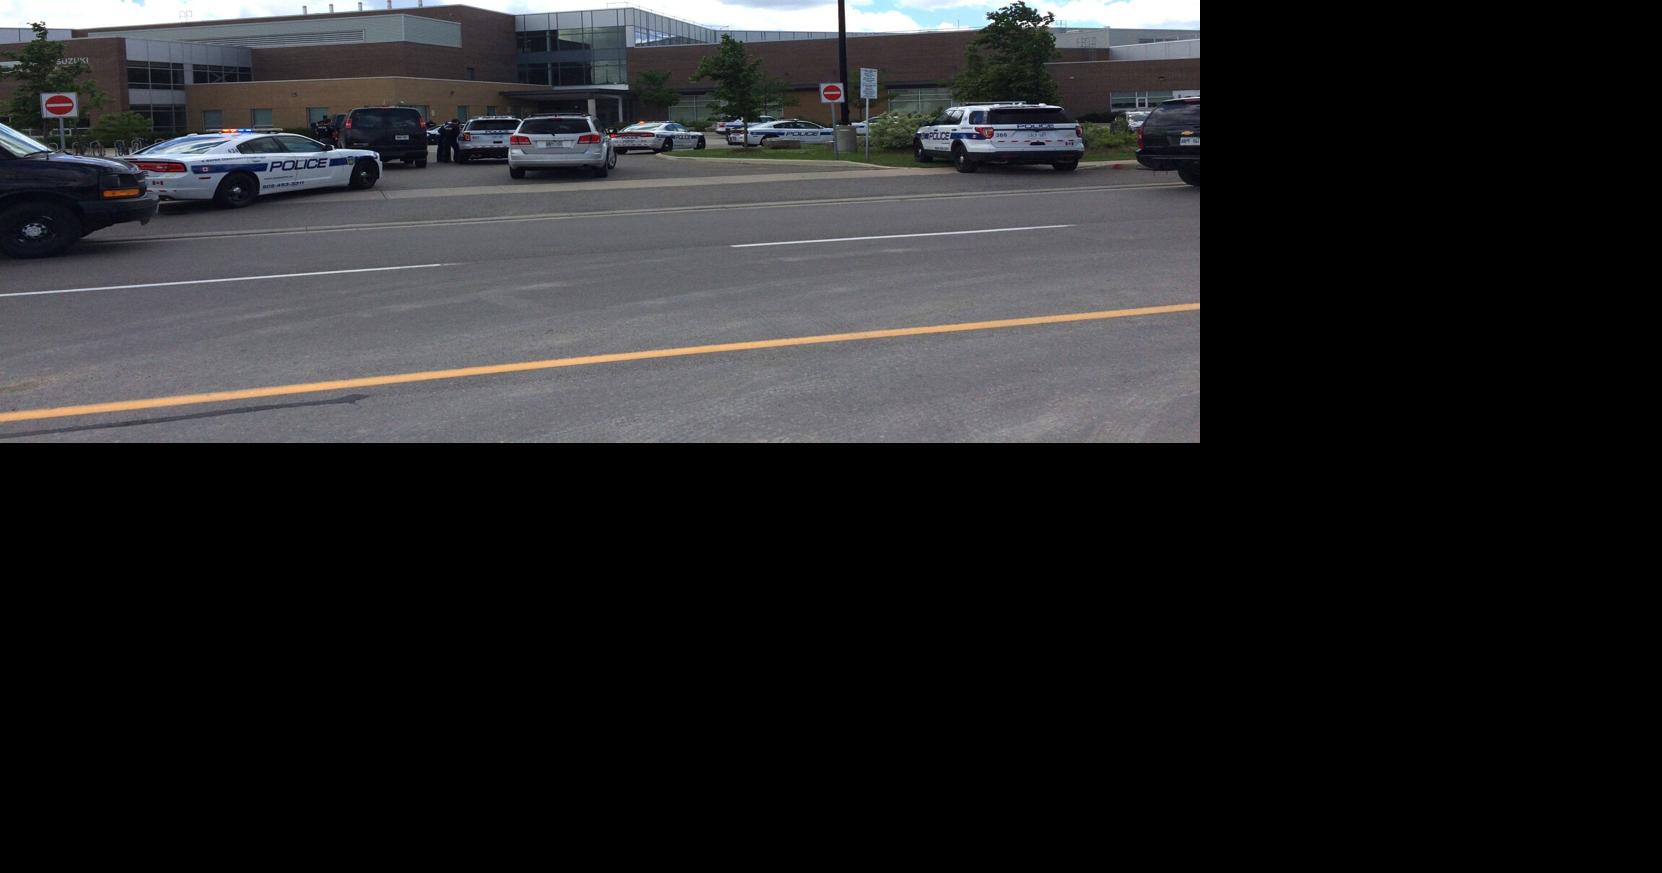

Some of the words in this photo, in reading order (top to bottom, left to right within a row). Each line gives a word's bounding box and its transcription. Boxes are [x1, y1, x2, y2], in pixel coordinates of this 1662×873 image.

[56, 57, 89, 65] SUZUKI
[929, 131, 951, 140] POLICE
[270, 158, 328, 172] POLICE
